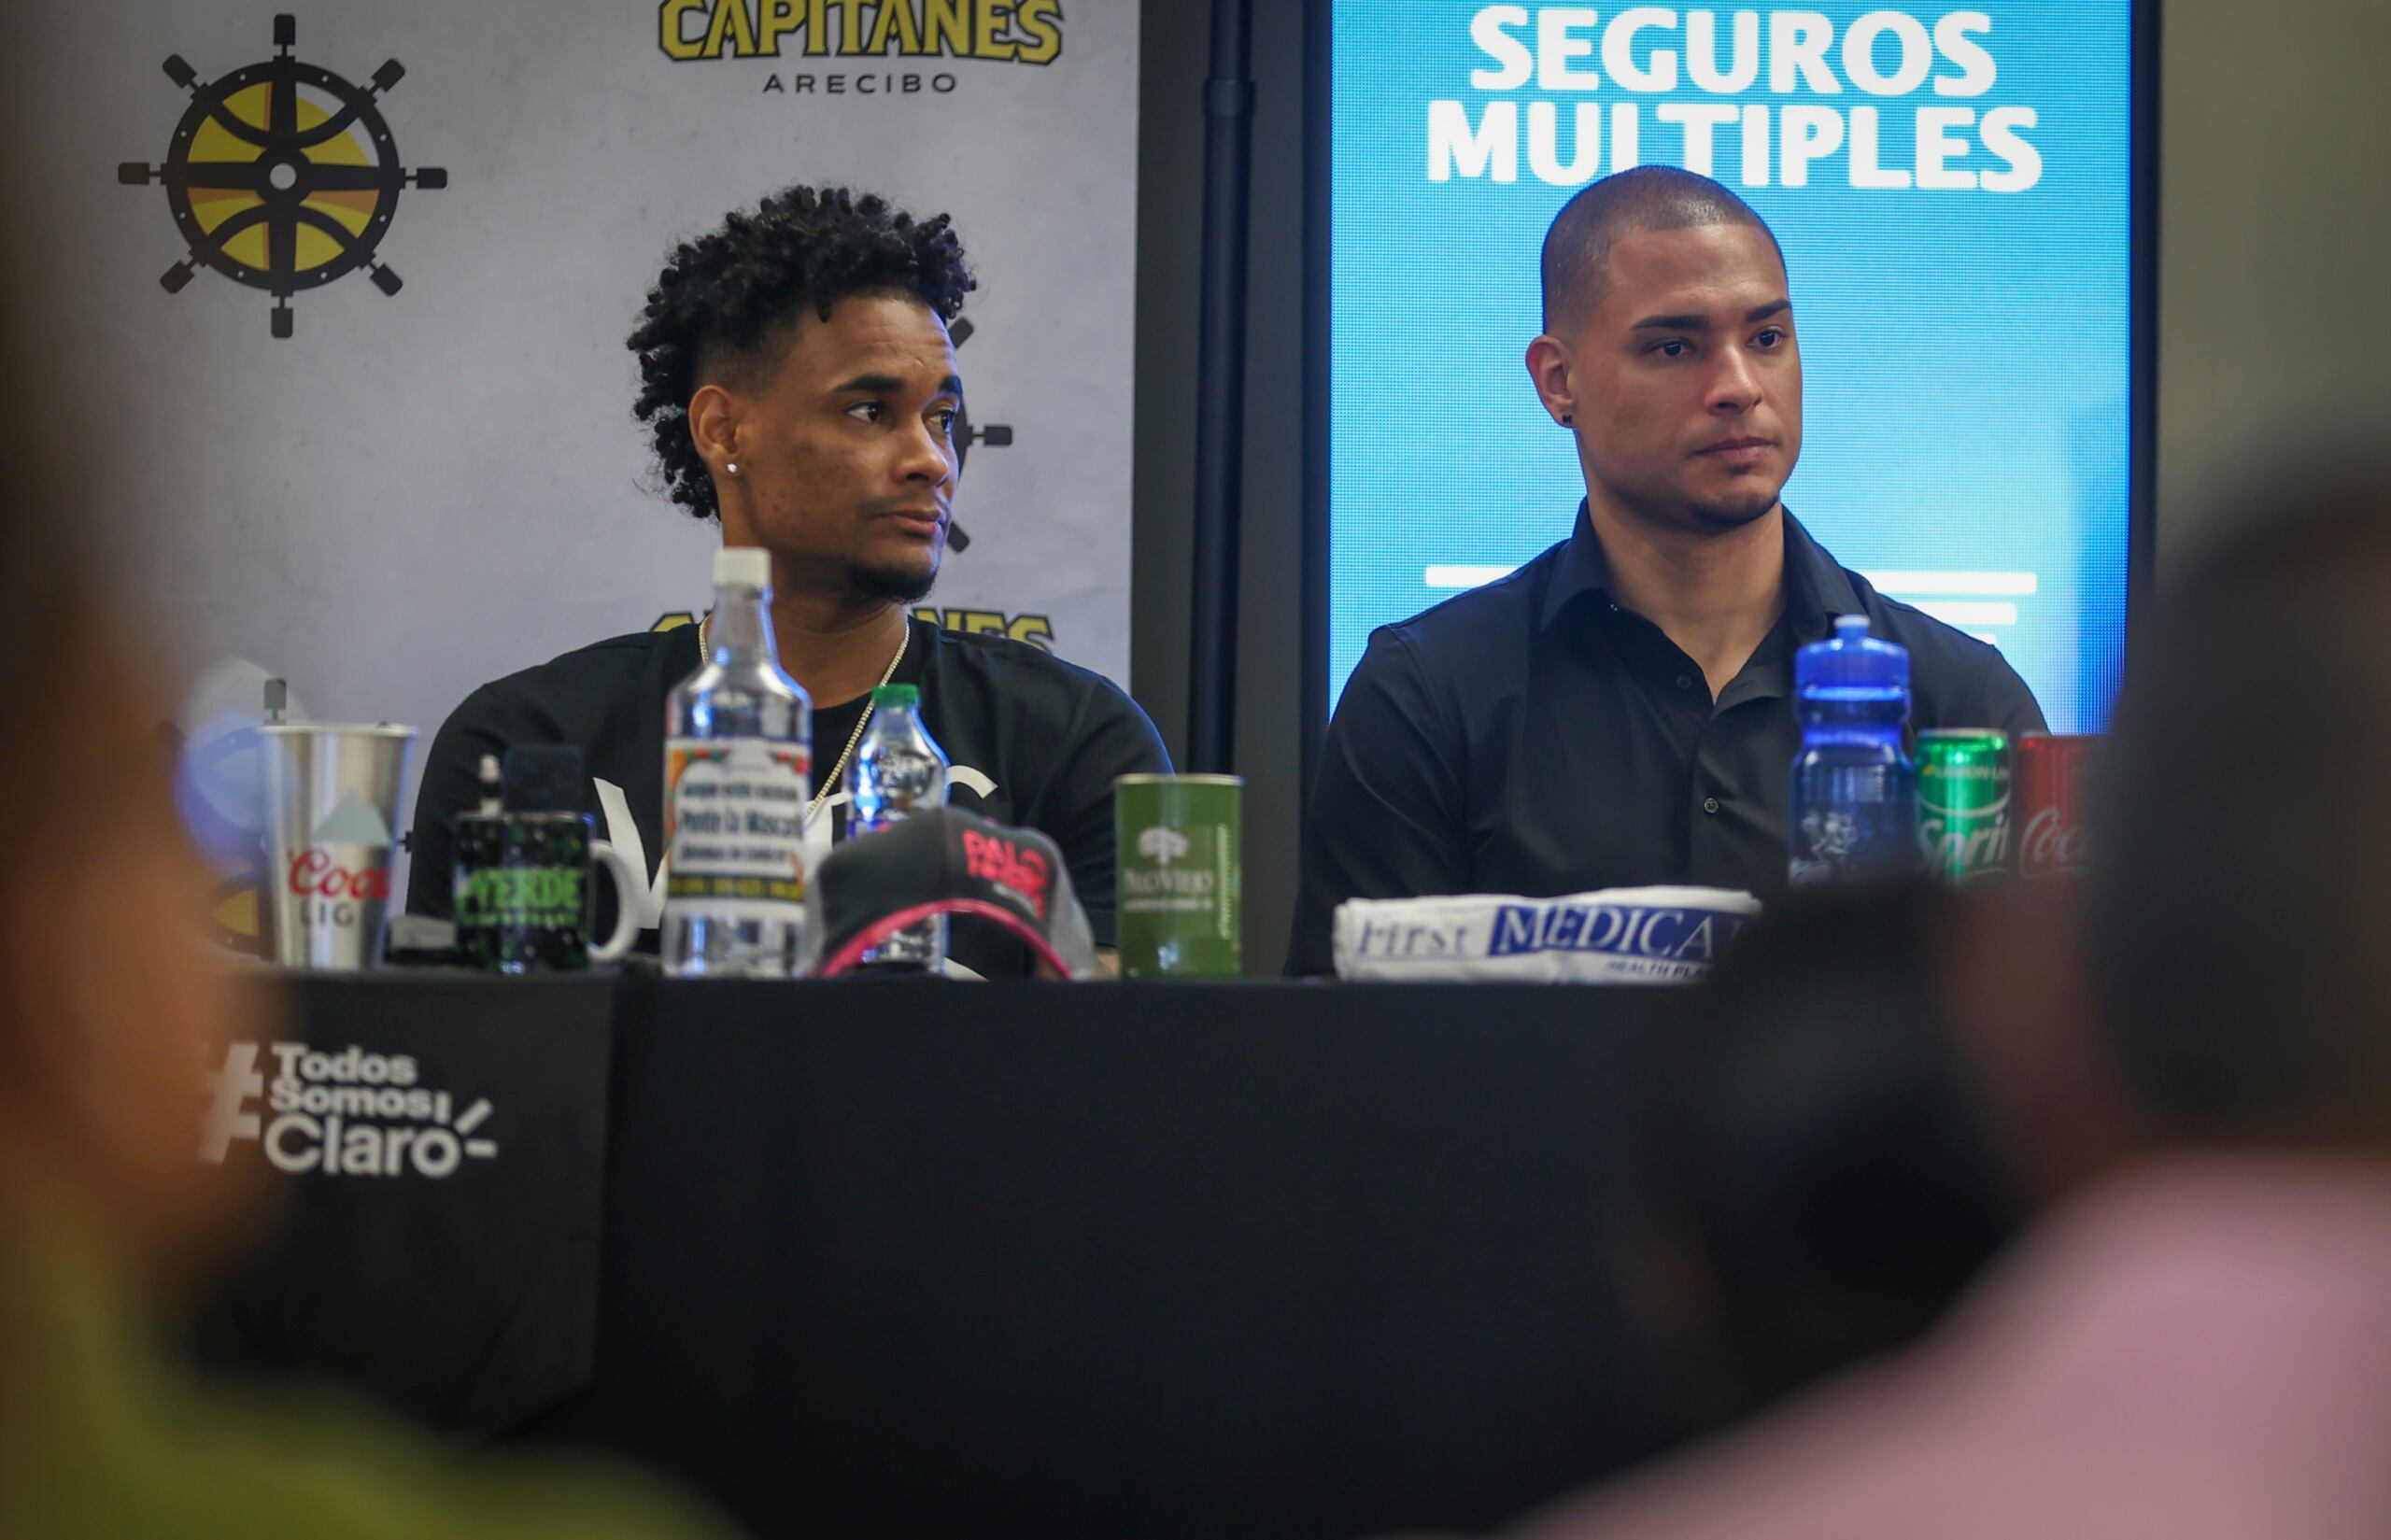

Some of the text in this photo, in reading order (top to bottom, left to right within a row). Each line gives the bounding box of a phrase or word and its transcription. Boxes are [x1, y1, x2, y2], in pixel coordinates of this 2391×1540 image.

[659, 0, 1063, 65] CAPITANES
[1469, 6, 1997, 97] SEGUROS
[763, 73, 958, 93] ARECIBO
[1427, 100, 2044, 192] MULTIPLES
[271, 1041, 418, 1085] Todos
[269, 1077, 434, 1120] Somos
[263, 1113, 462, 1179] Claro
